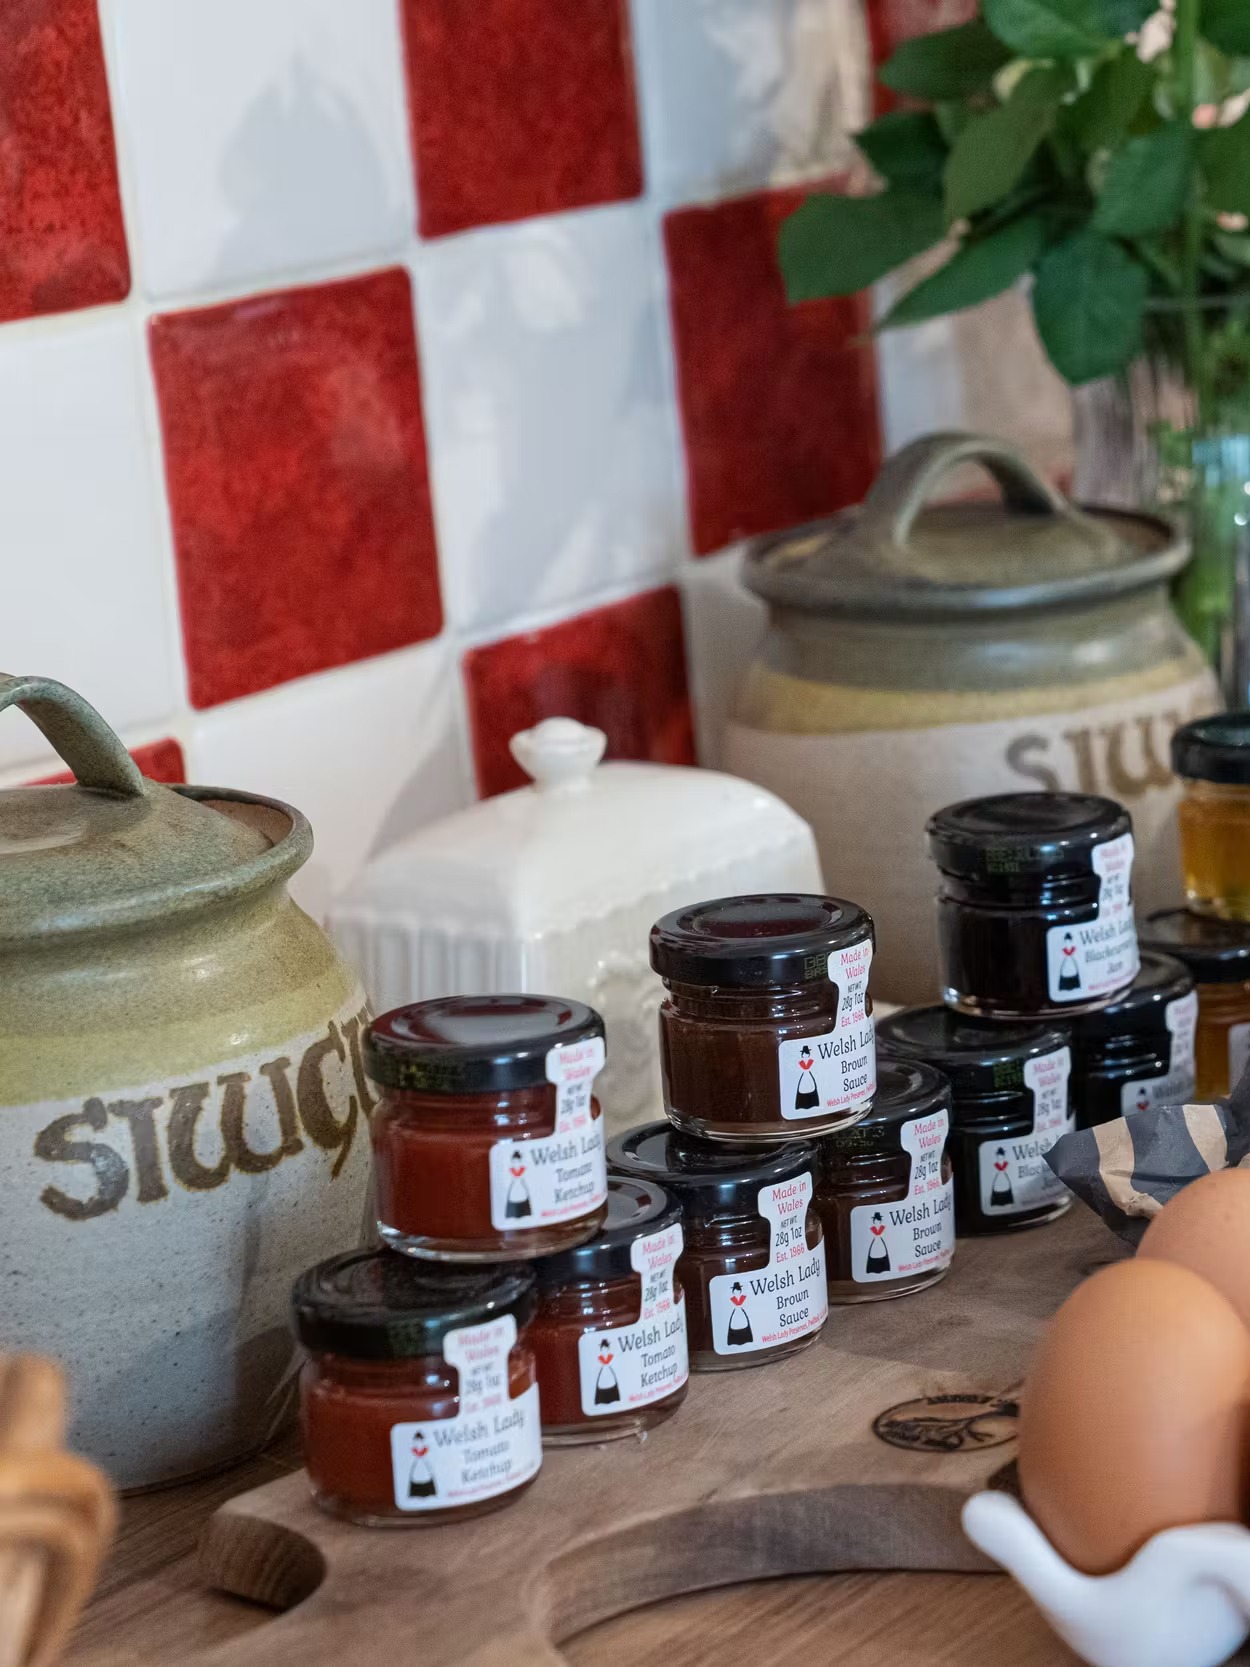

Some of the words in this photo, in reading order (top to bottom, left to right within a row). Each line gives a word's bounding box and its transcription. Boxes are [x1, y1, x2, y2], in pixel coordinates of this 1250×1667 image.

[1080, 923, 1116, 945] Welsh
[840, 950, 862, 966] Made
[862, 946, 869, 959] in
[845, 965, 866, 980] Wales
[841, 996, 853, 1012] 28g
[854, 993, 864, 1007] 1oz
[817, 1034, 857, 1060] Welsh
[840, 1055, 868, 1075] Brown
[843, 1073, 868, 1092] Sauce
[913, 1121, 936, 1136] Made
[937, 1117, 944, 1128] in
[918, 1133, 941, 1149] Wales
[530, 1140, 578, 1166] Welsh
[555, 1161, 593, 1183] Tomato
[914, 1165, 926, 1180] 28g
[928, 1160, 938, 1174] 1oz
[553, 1180, 595, 1204] Ketchup
[772, 1183, 797, 1201] Made
[799, 1180, 807, 1193] in
[777, 1198, 804, 1216] Wales
[889, 1201, 930, 1226] Welsh
[933, 1193, 952, 1215] Lady
[780, 1216, 790, 1228] NET
[912, 1222, 942, 1241] Brown
[642, 1237, 666, 1256] Made
[775, 1231, 789, 1248] 28g
[791, 1226, 803, 1240] 1oz
[776, 1251, 788, 1264] Est.
[790, 1242, 806, 1258] 1966
[914, 1239, 942, 1258] Sauce
[647, 1252, 673, 1270] Wales
[750, 1269, 795, 1296] Welsh
[798, 1257, 821, 1282] Lady
[776, 1288, 810, 1310] Brown
[779, 1307, 810, 1328] Sauce
[617, 1325, 661, 1353] Welsh
[641, 1344, 676, 1368] Tomato
[640, 1361, 679, 1388] Ketchup
[433, 1421, 489, 1449] Welsh
[493, 1409, 525, 1434] Lady
[463, 1438, 511, 1464] Tomato
[461, 1458, 514, 1485] Ketchup
